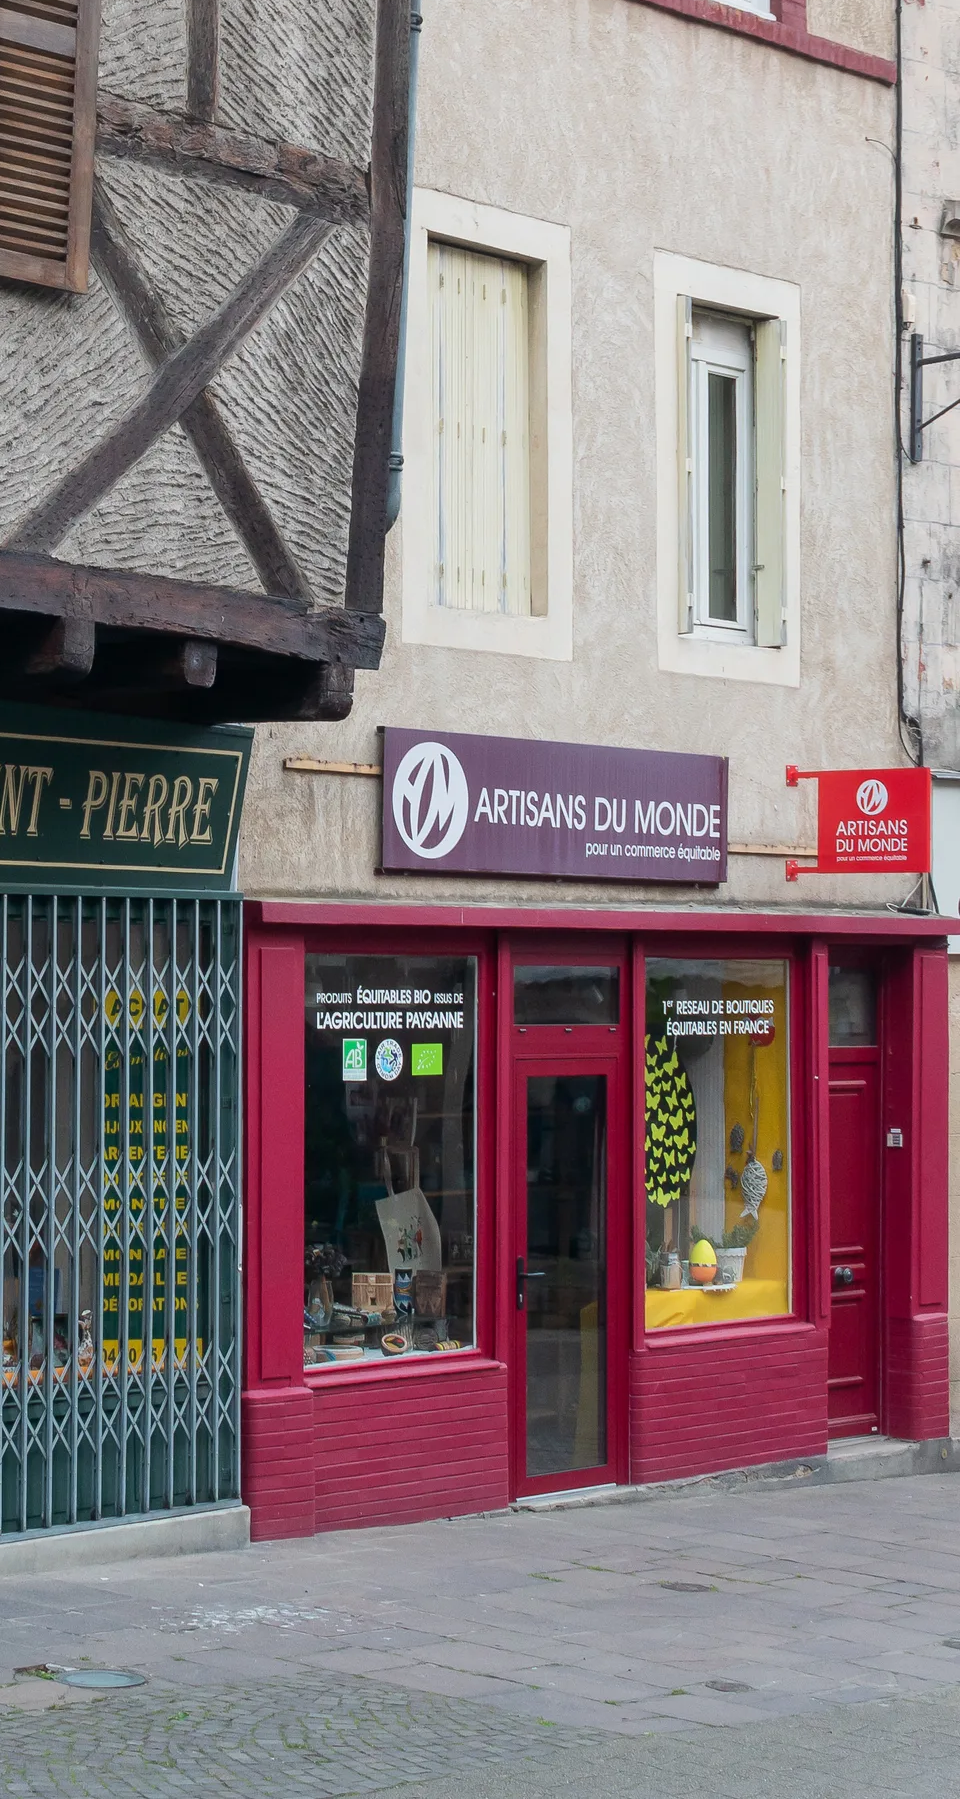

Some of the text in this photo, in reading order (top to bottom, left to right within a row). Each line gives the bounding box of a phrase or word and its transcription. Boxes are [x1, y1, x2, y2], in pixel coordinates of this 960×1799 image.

[79, 770, 219, 850] PIERRE
[474, 787, 721, 838] ARTISANS DU MONDE
[836, 819, 908, 836] ARTISANS
[586, 843, 721, 862] pour un commerce équitable
[836, 838, 908, 852] DU MONDE
[883, 854, 907, 862] équitable
[316, 985, 464, 1004] PRODUITS ÉQUITABLES BIO ISSUS DE
[662, 999, 774, 1015] 1er RESEAU DE BOUTIQUES
[316, 1011, 464, 1030] L'AGRICULTURE PAYSANNE
[666, 1017, 770, 1035] ÉQUITABLES EN FRANCE
[345, 1048, 363, 1068] AB
